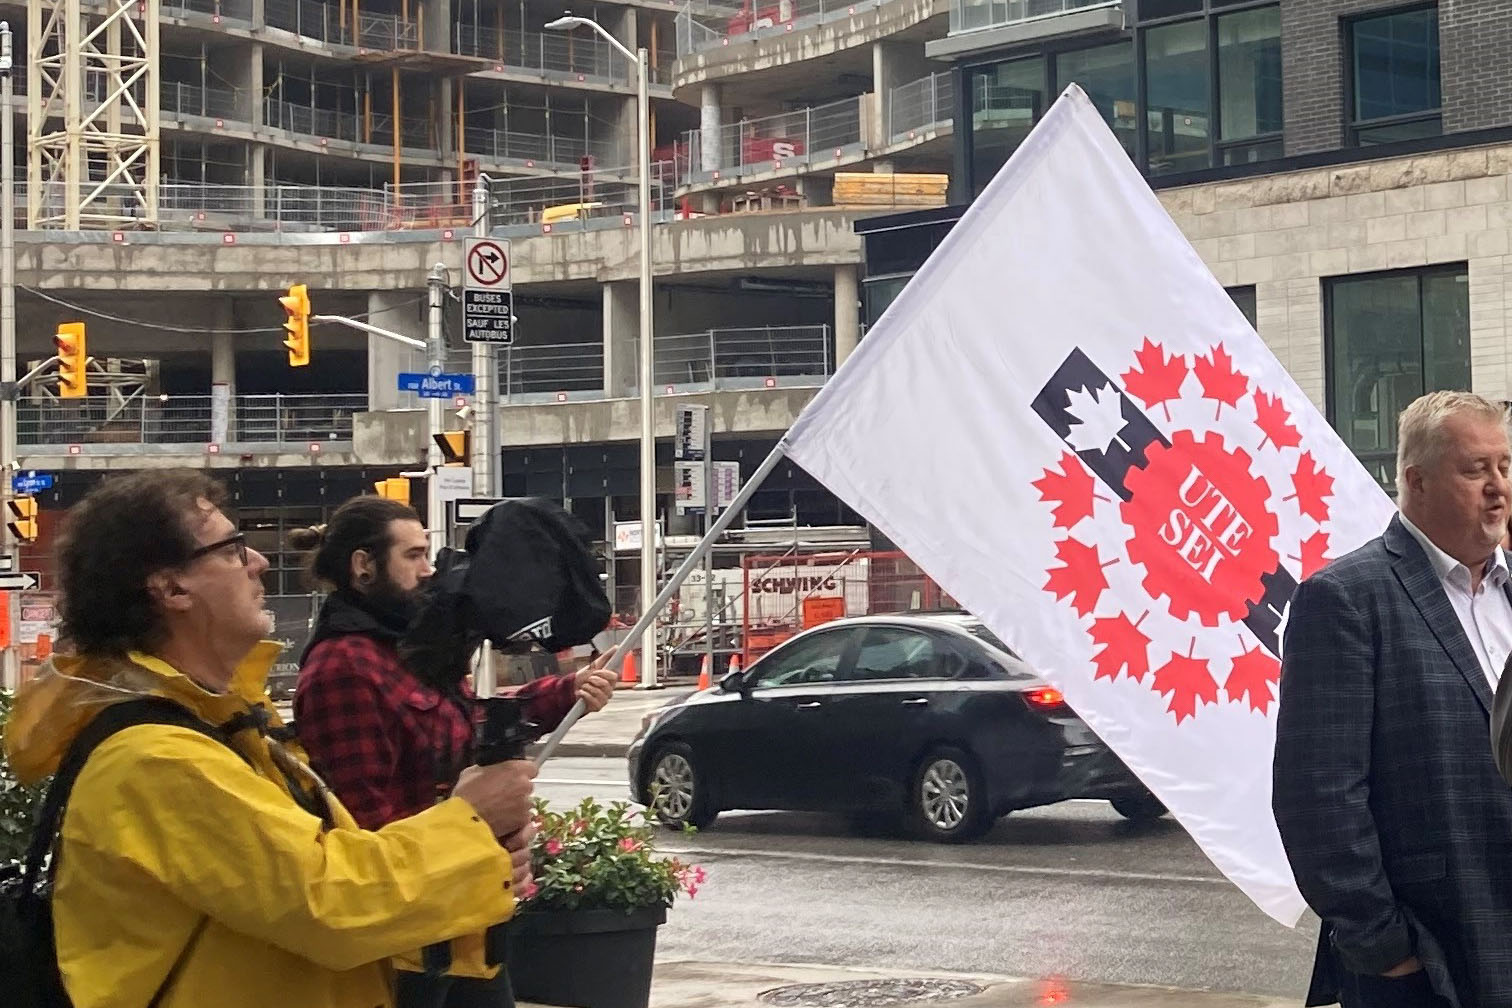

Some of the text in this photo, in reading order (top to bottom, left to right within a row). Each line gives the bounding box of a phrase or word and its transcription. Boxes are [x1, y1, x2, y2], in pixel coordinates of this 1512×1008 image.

[474, 294, 501, 303] BUSES
[467, 304, 509, 314] EXCEPTED
[467, 319, 509, 329] SAUF LES
[469, 330, 507, 339] AUTOBUS
[422, 378, 452, 390] Albert
[1178, 464, 1254, 557] UTE
[1157, 508, 1225, 584] SEI
[751, 576, 836, 594] SCHWING
